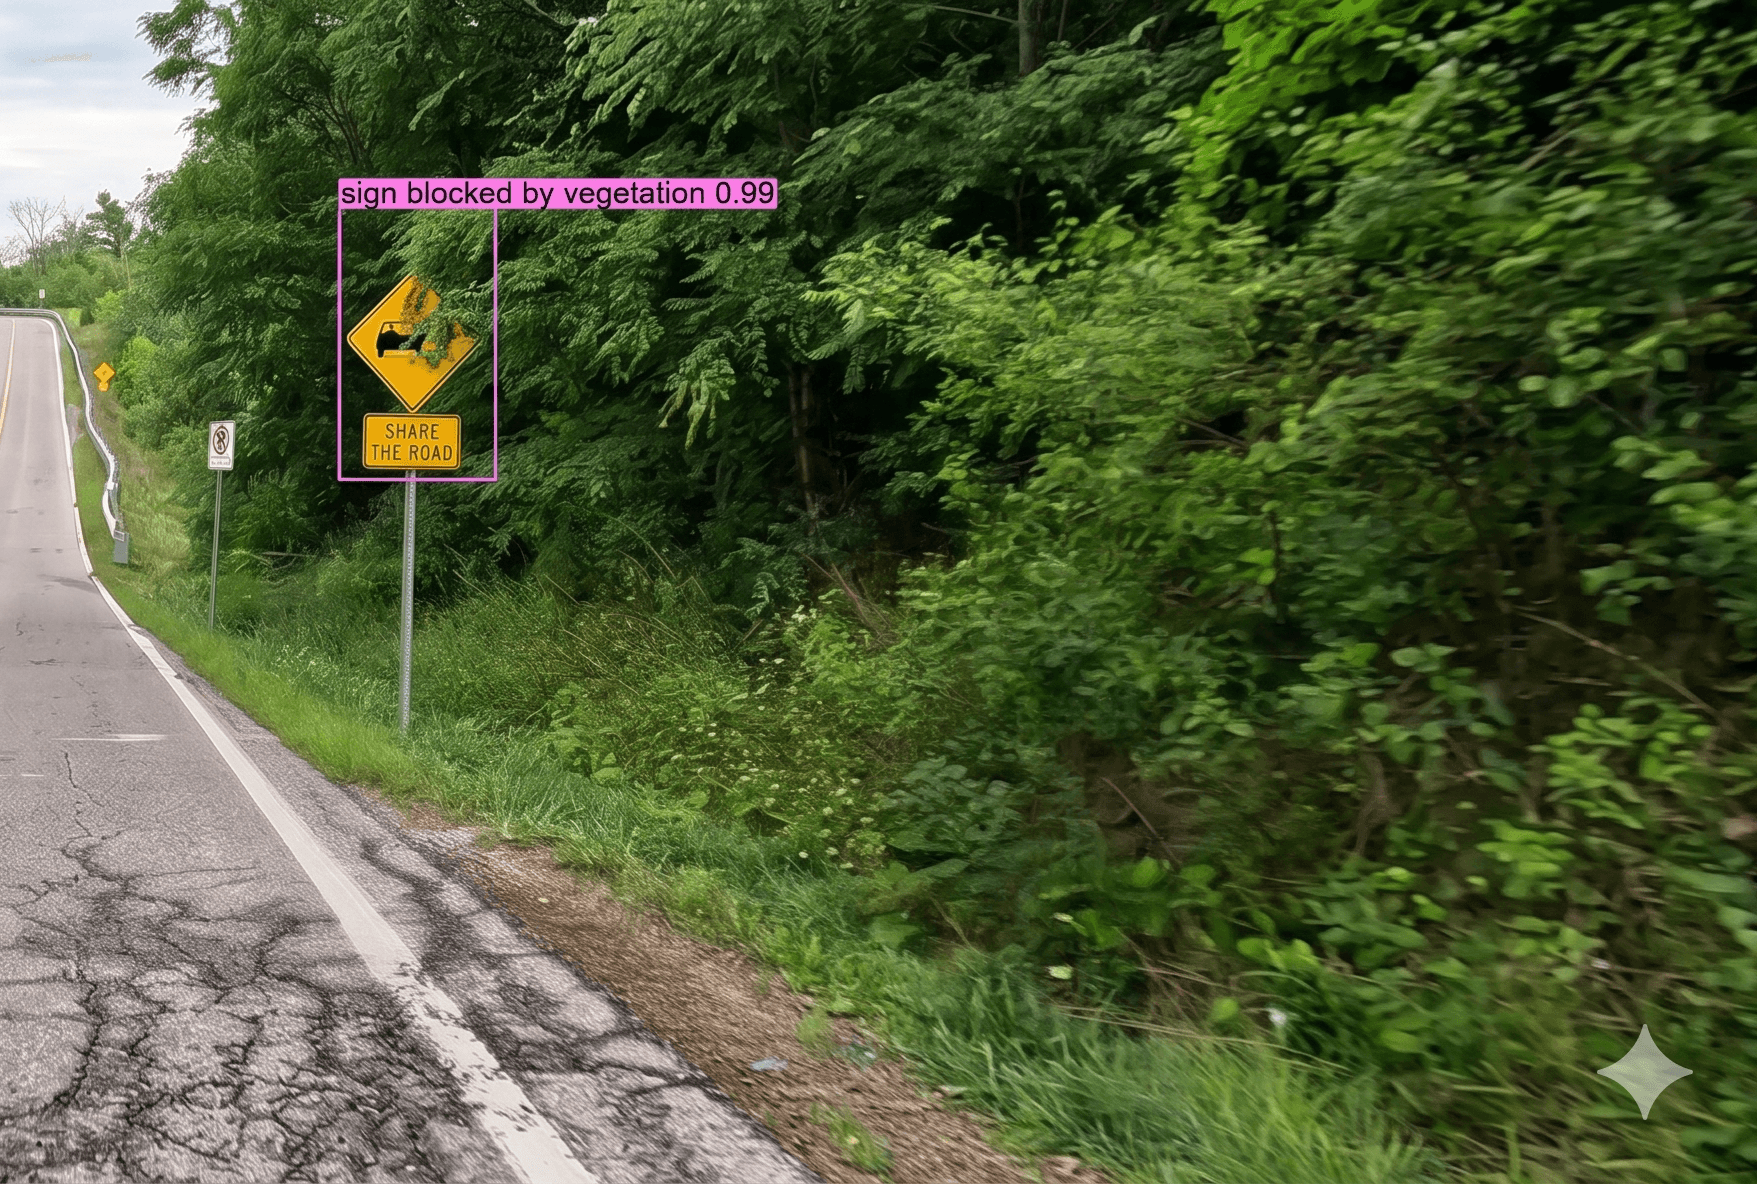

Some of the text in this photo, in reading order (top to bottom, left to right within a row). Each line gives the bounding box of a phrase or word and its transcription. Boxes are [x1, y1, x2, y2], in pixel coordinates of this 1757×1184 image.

[385, 423, 440, 440] SHARE
[371, 444, 453, 461] THE ROAD
